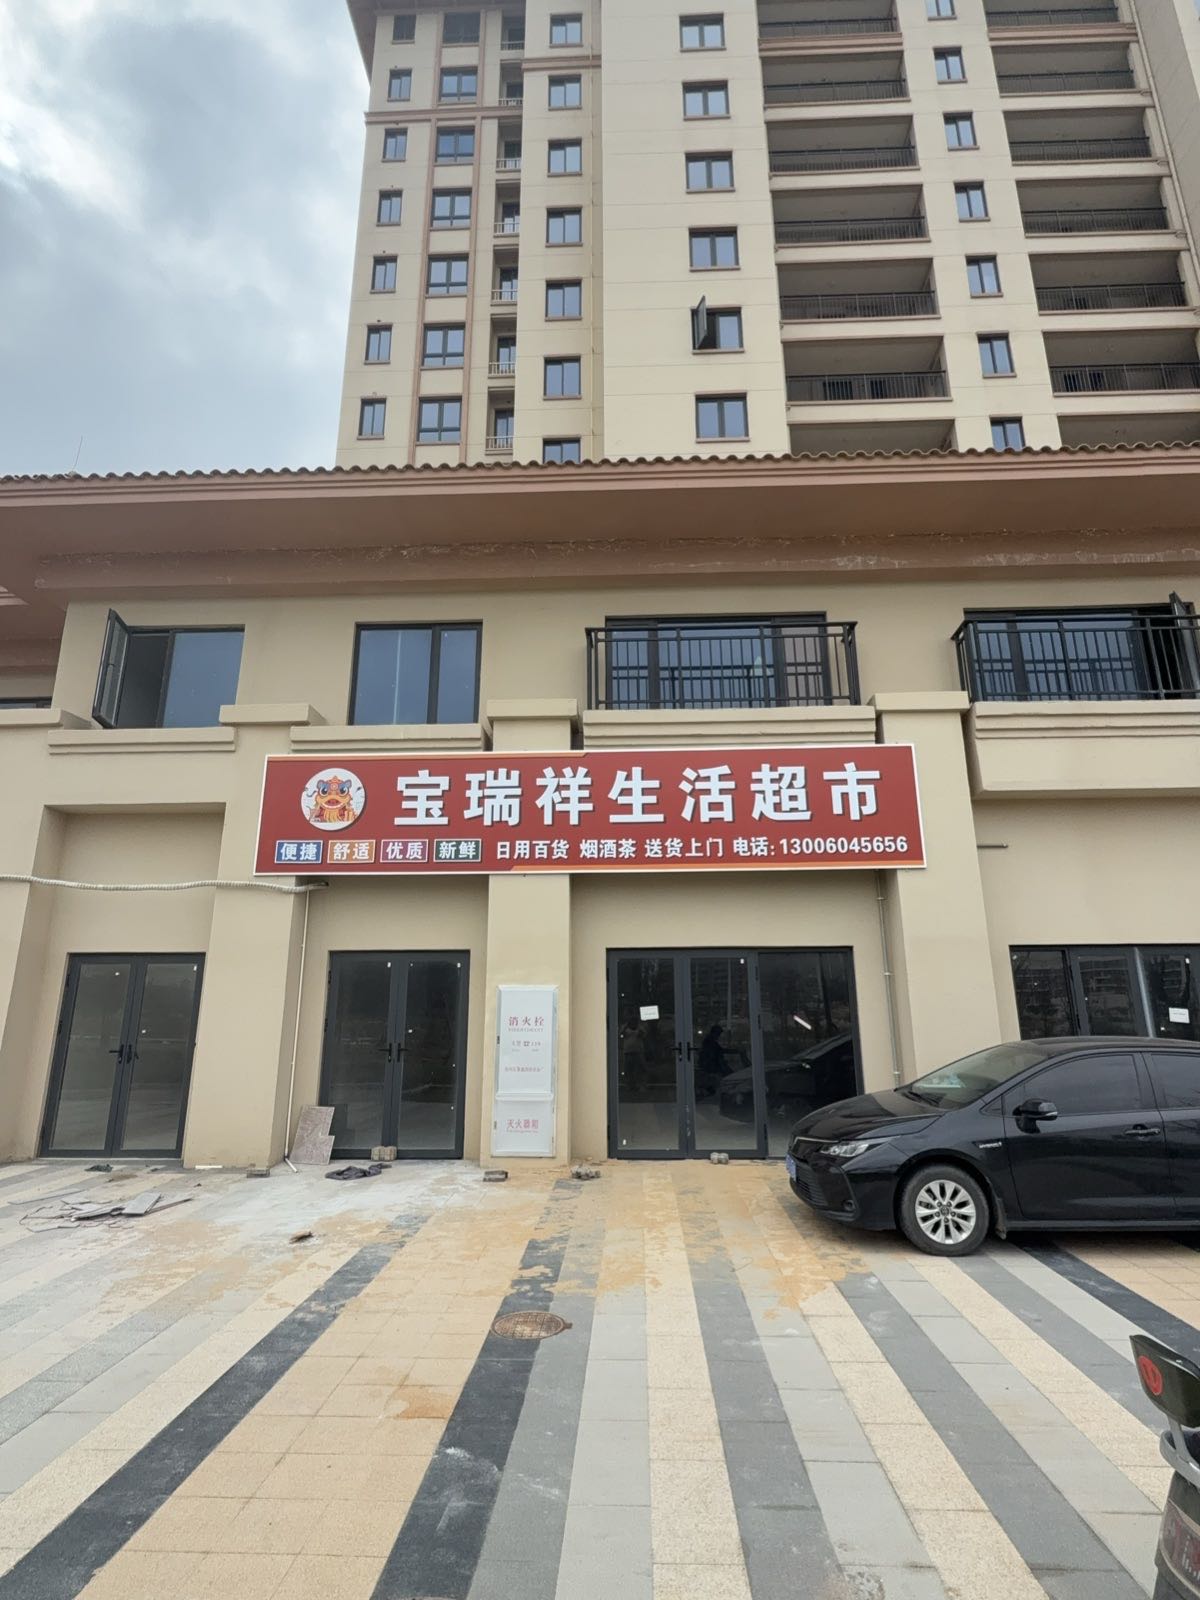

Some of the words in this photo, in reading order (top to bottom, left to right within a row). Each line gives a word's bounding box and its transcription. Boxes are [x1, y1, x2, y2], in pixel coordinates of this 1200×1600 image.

[394, 762, 881, 826] 宝瑞祥生活超市
[280, 842, 317, 861] 便捷
[333, 842, 370, 861] 舒适
[386, 841, 423, 860] 优质
[438, 841, 476, 860] 新鲜
[496, 840, 570, 859] 日用百货
[580, 839, 636, 859] 烟酒茶
[645, 838, 723, 858] 送货上门
